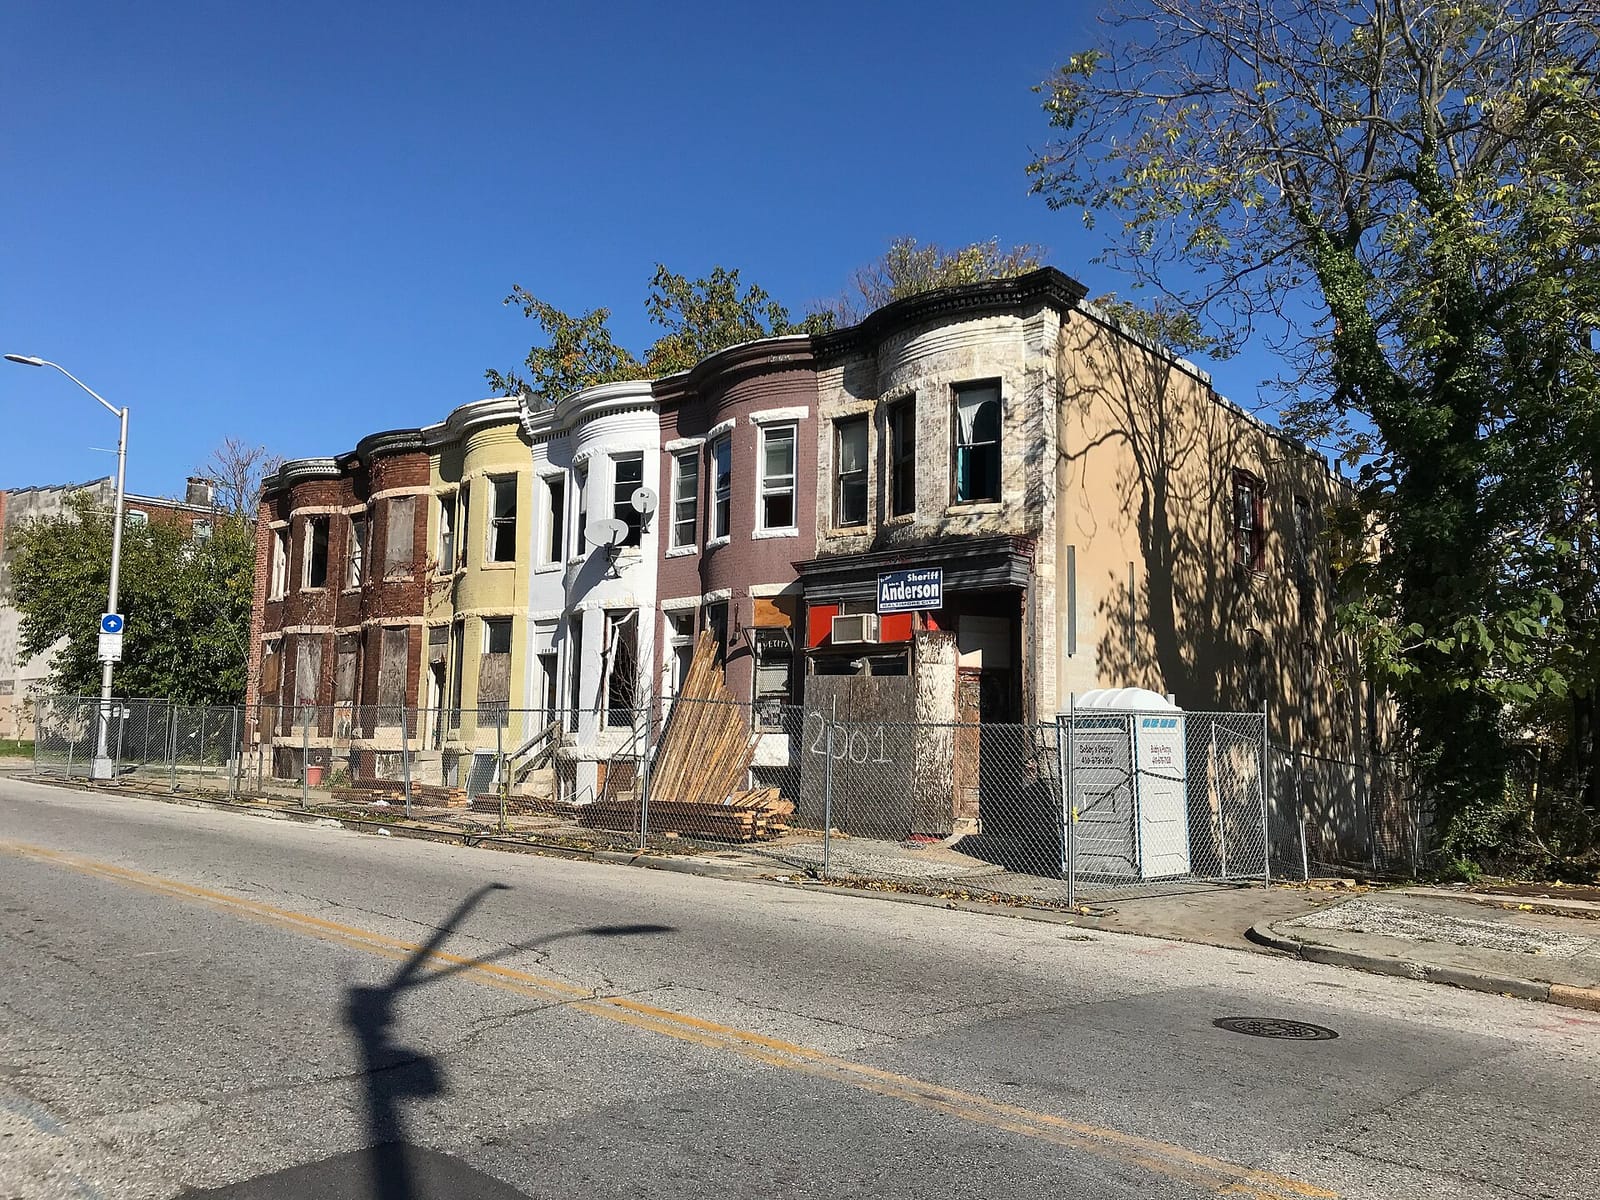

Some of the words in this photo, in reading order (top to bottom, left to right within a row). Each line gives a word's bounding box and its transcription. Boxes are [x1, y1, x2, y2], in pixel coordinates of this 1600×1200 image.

[907, 571, 939, 582] Sheriff
[882, 581, 939, 601] Anderson
[808, 711, 892, 763] 2001
